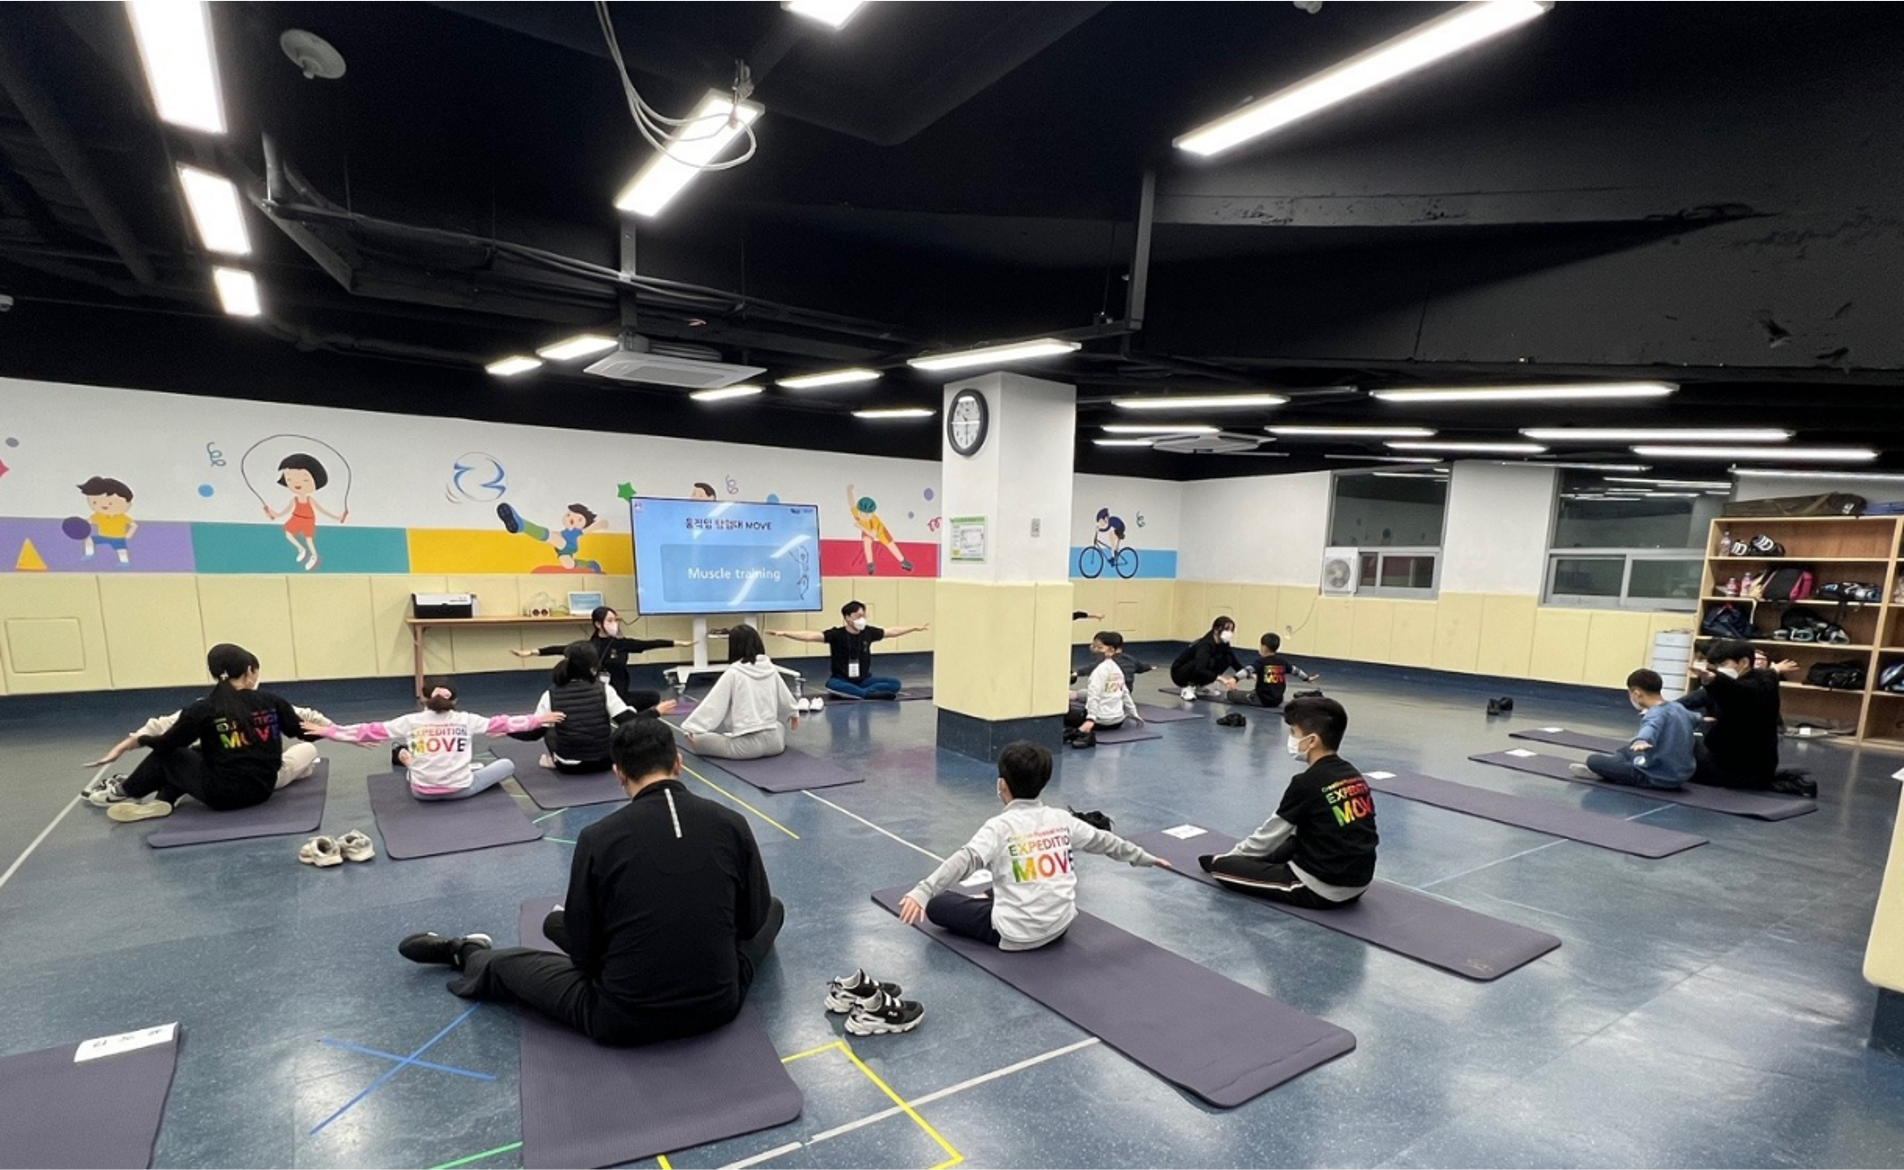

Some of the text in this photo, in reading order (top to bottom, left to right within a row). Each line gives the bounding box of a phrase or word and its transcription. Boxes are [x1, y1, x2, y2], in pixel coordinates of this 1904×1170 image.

[745, 521, 772, 531] MOVE
[687, 567, 781, 582] Muscle training
[411, 738, 467, 755] MOVE
[1332, 797, 1371, 827] MOV
